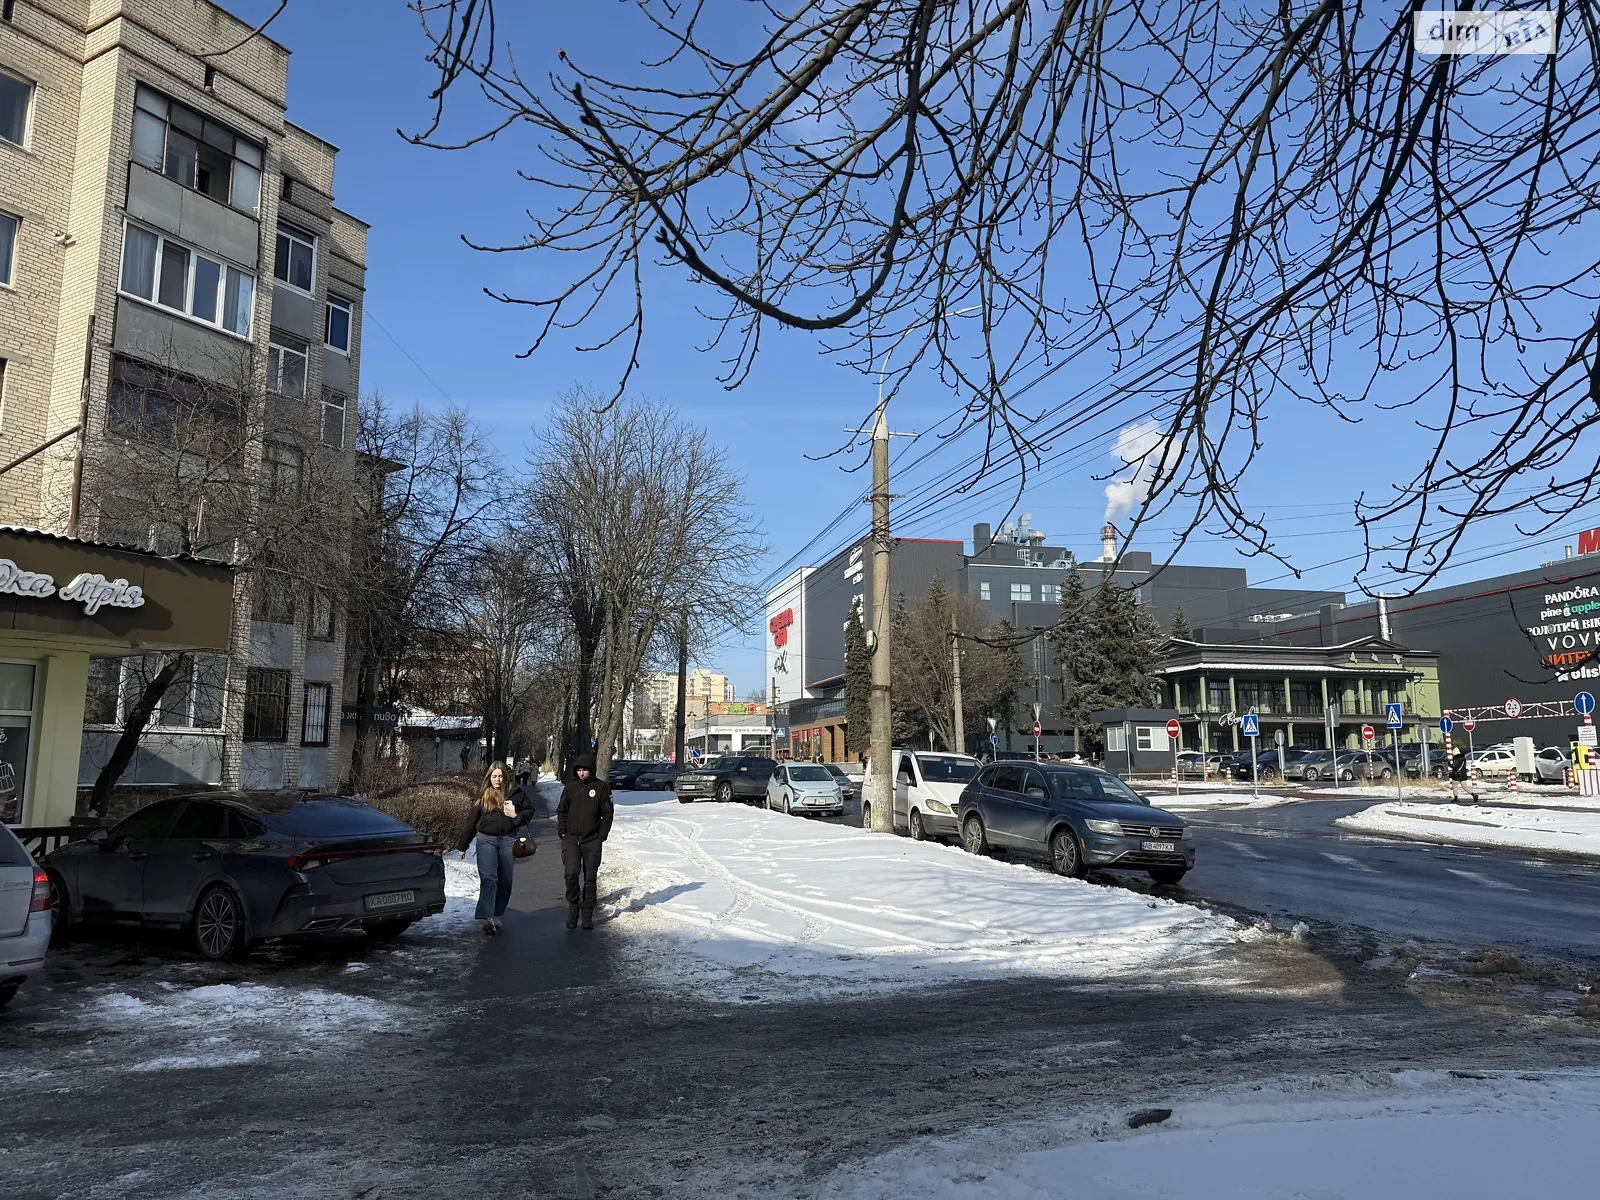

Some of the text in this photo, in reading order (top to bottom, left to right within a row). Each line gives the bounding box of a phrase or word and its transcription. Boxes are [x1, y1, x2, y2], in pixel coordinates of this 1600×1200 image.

[60, 573, 145, 615] Мрія
[1544, 586, 1600, 605] PANDORA
[1540, 608, 1562, 621] pine
[1571, 601, 1600, 615] apple
[374, 711, 397, 722] пиво
